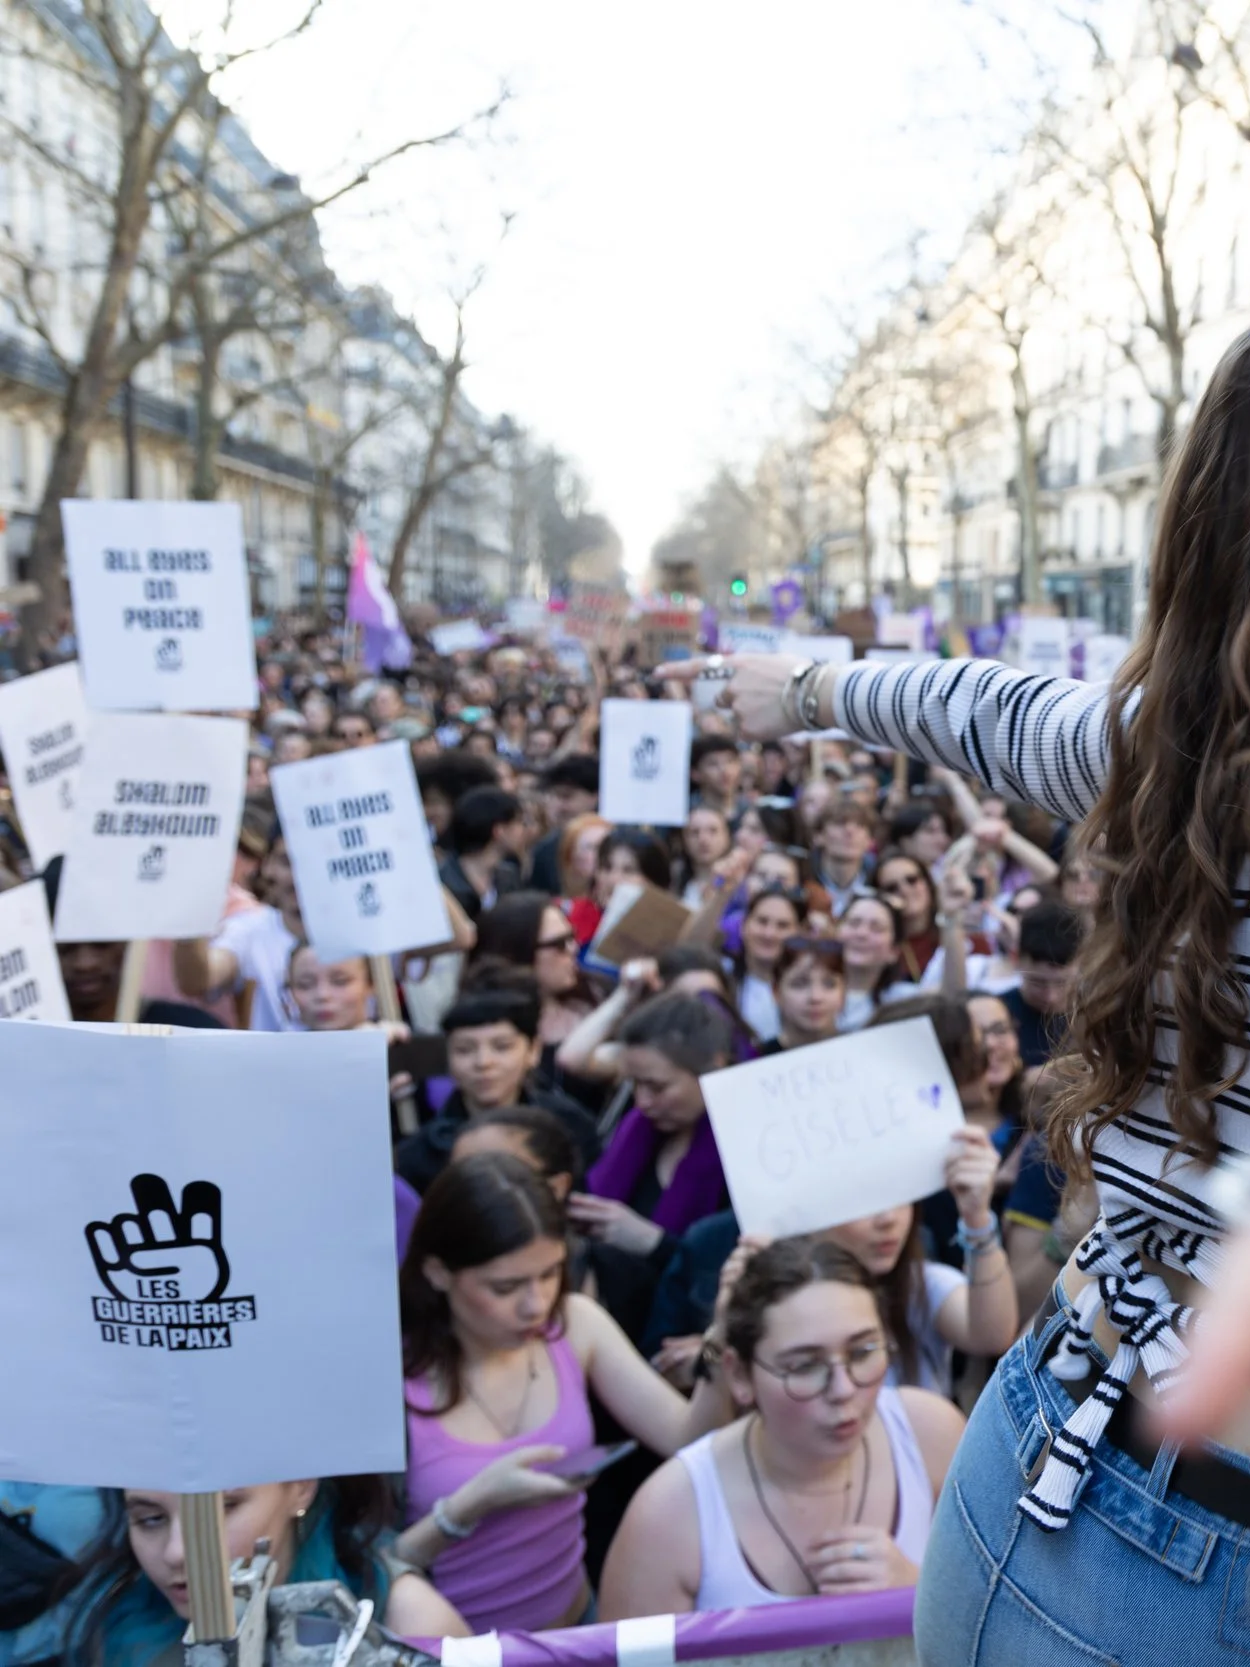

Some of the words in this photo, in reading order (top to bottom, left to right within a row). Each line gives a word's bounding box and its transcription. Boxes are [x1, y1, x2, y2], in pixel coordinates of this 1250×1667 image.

[105, 549, 142, 572] ALL
[147, 549, 211, 572] EYES
[143, 578, 177, 602] ON
[123, 607, 203, 632] PEACE
[115, 779, 209, 807] SHALOM
[306, 805, 337, 829] ALL
[339, 792, 392, 820] EYES
[340, 825, 367, 849] ON
[328, 850, 393, 881] PEACE
[758, 1058, 853, 1108] MERCI
[137, 1279, 180, 1298] LES
[96, 1297, 254, 1325] GUERRIÈRES
[101, 1323, 130, 1345] DE
[136, 1327, 165, 1348] LA
[169, 1327, 228, 1348] PAIX
